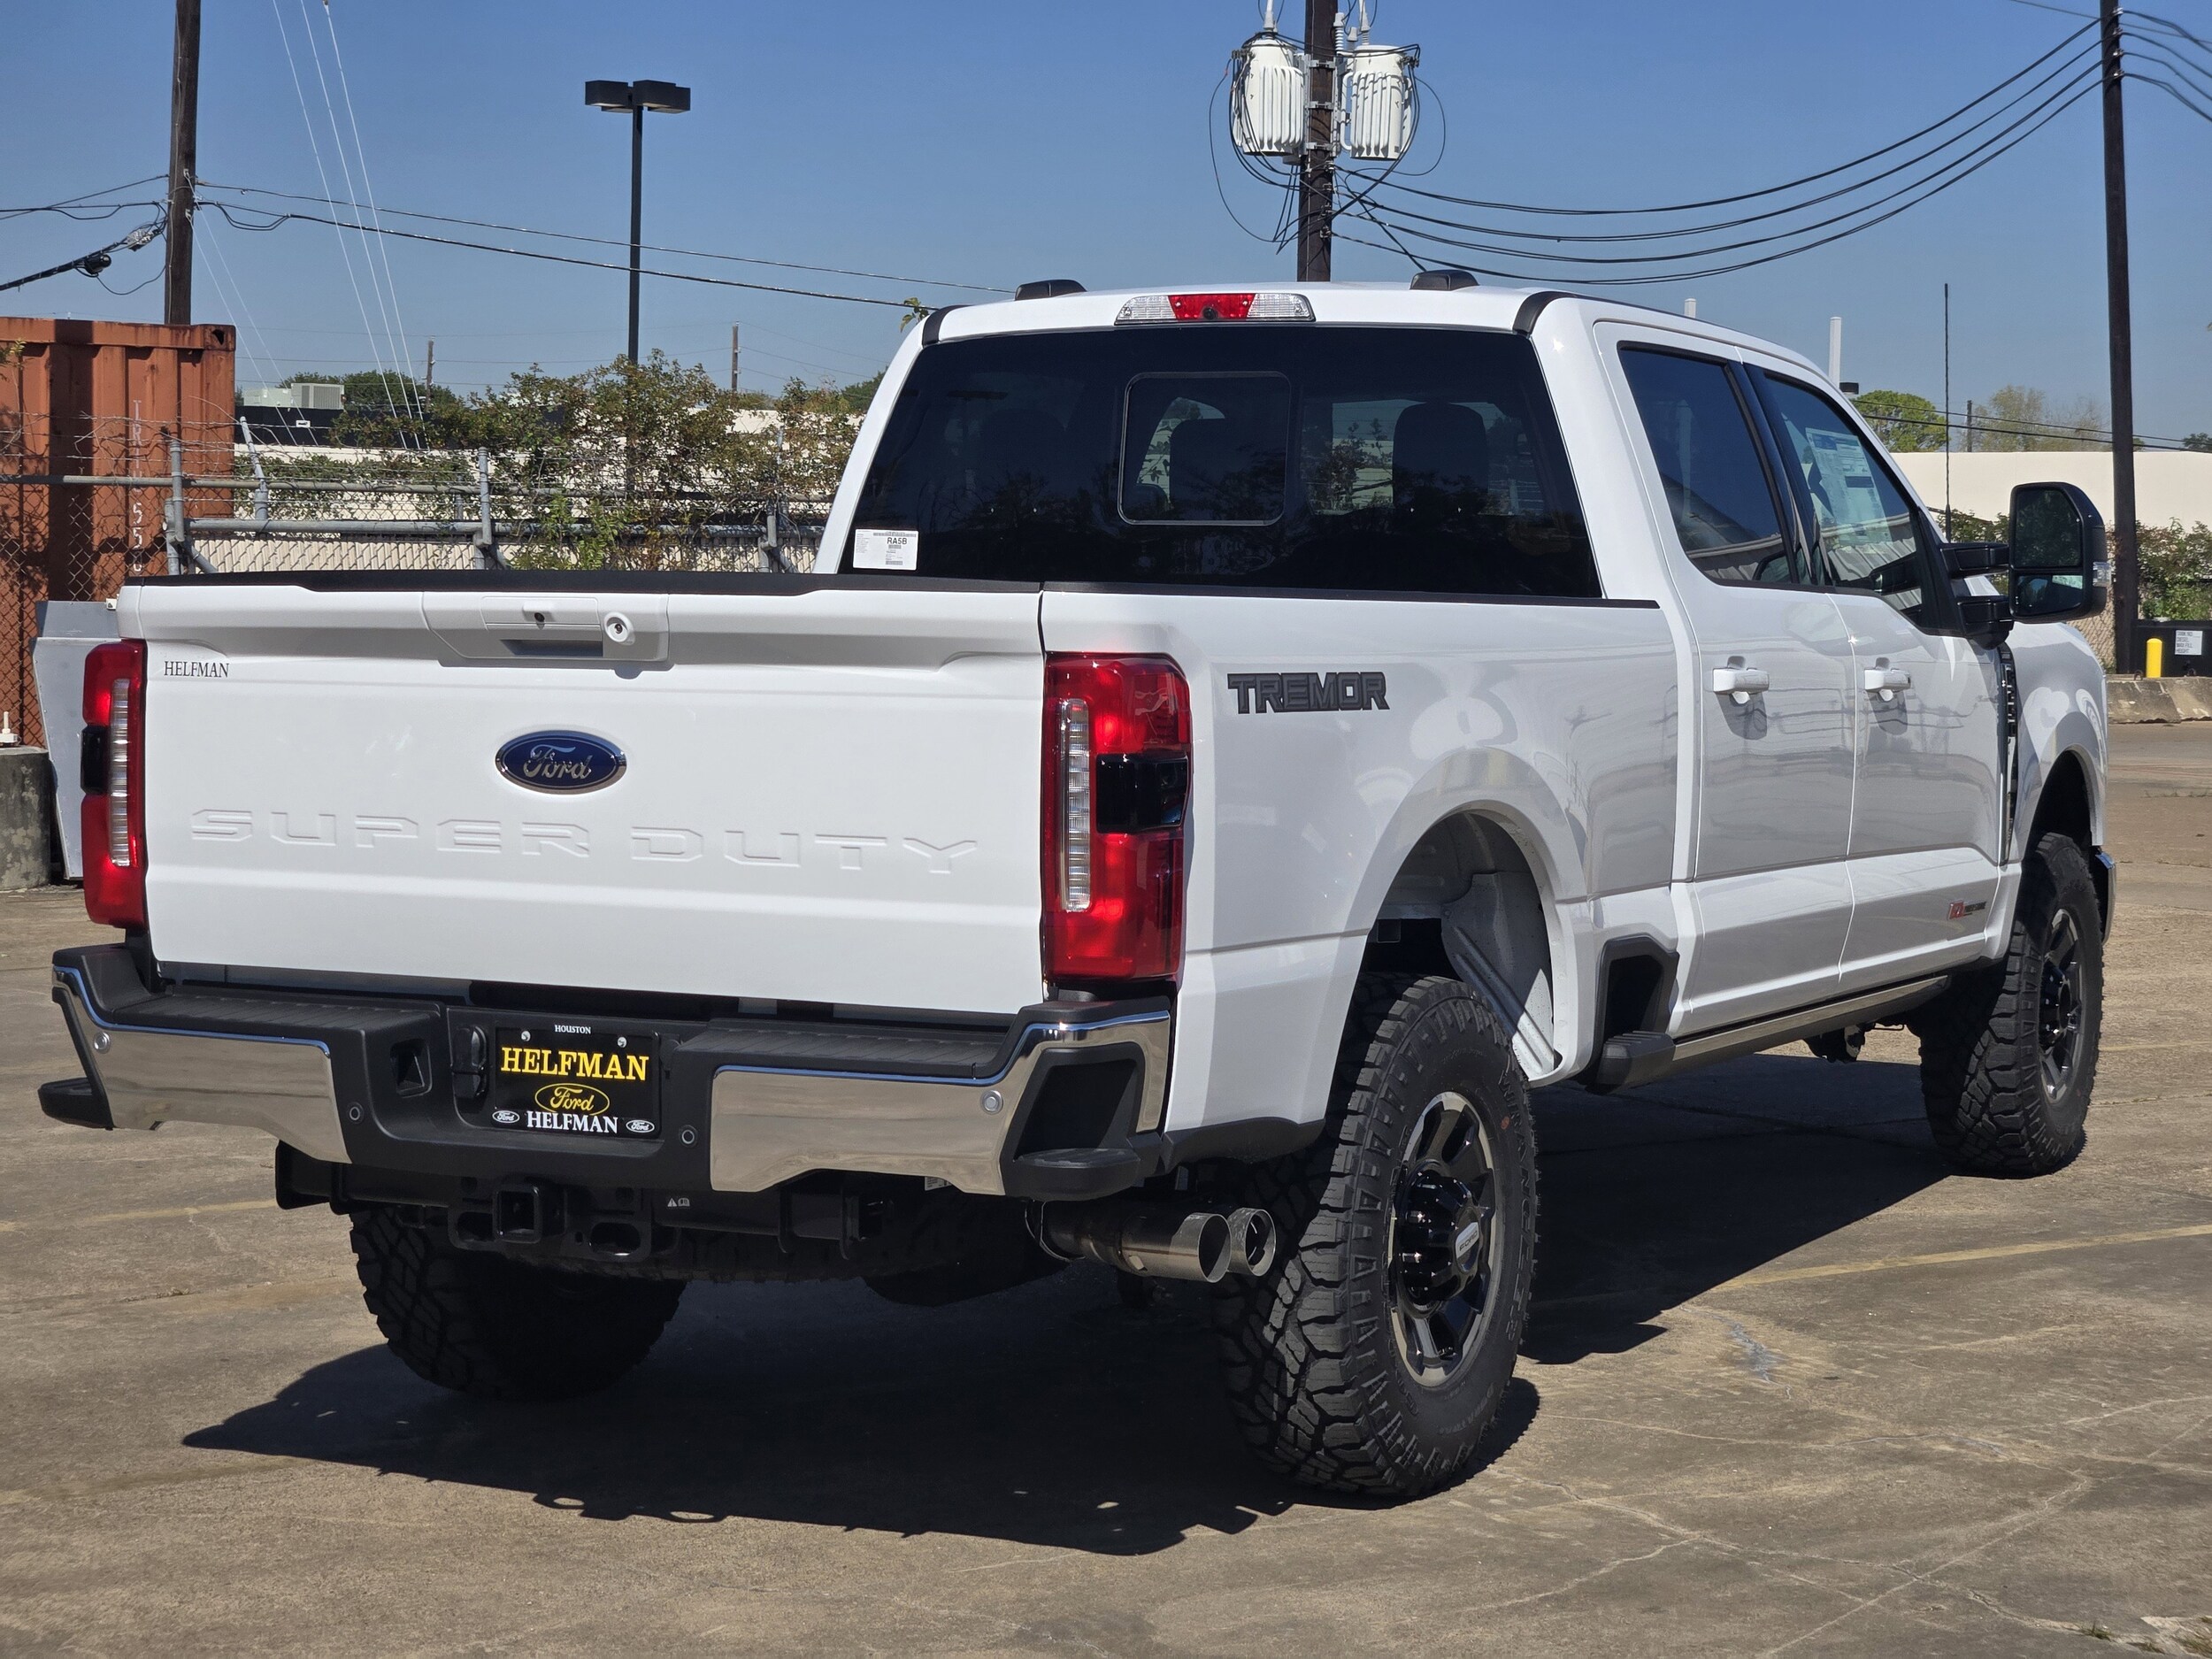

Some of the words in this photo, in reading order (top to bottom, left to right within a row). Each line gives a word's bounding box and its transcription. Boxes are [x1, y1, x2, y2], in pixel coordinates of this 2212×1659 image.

[164, 661, 229, 678] HELFMAN
[1227, 672, 1390, 714] TREMOR
[523, 744, 593, 780] Ford
[191, 810, 589, 859] SUPER
[632, 827, 978, 874] DUTY
[554, 1025, 591, 1034] HOUSTON
[500, 1047, 649, 1080] HELFMAN
[549, 1087, 594, 1111] Ford
[526, 1110, 618, 1133] HELFMAN
